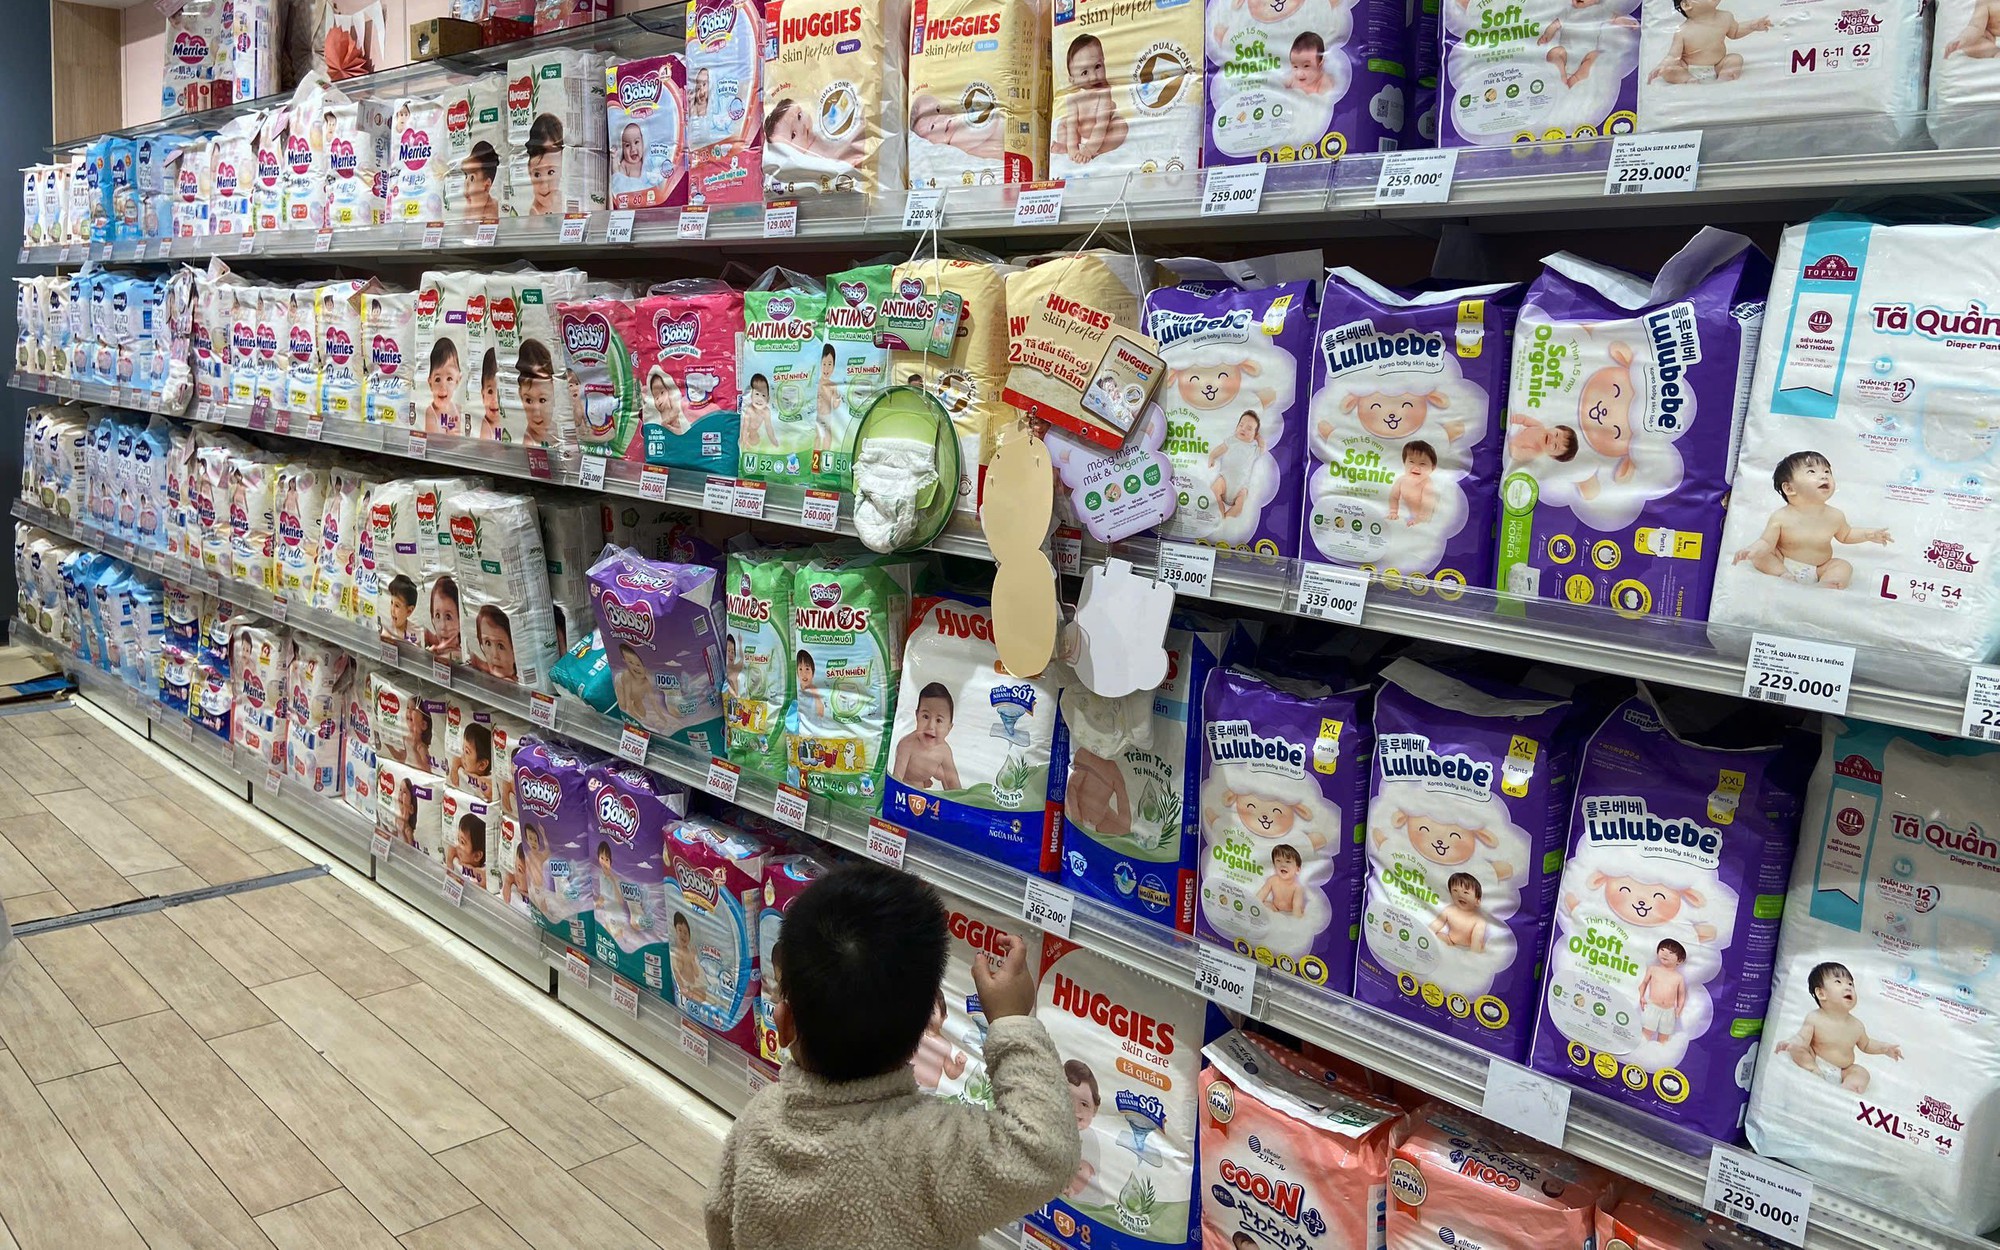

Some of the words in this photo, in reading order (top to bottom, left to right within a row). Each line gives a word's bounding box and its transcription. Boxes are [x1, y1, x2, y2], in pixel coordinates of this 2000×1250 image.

[782, 8, 861, 44] HUGGIES
[927, 13, 1000, 40] HUGGIES
[1080, 12, 1108, 26] skin
[1481, 5, 1522, 30] Soft
[1465, 20, 1540, 49] Organic
[173, 42, 209, 59] Merries
[782, 48, 802, 63] skin
[804, 41, 835, 64] perfect
[1235, 40, 1265, 61] Soft
[1791, 48, 1816, 73] M
[1823, 48, 1844, 58] 6-11
[1852, 44, 1870, 56] 62
[1224, 53, 1281, 78] Organic
[1826, 58, 1839, 68] kg
[330, 151, 357, 170] Merries
[400, 143, 432, 160] Merries
[1387, 172, 1443, 187] 259.000đ
[1619, 165, 1691, 181] 229.000đ
[633, 195, 642, 204] 60
[1210, 188, 1257, 203] 259.000đ
[1018, 202, 1059, 216] 299.000đ
[766, 218, 794, 230] 129.000đ
[1807, 269, 1855, 278] TOPVALU
[769, 303, 792, 314] Bobby
[1046, 294, 1111, 330] HUGGIES
[1466, 303, 1476, 314] L
[1042, 313, 1066, 328] skin
[1066, 319, 1105, 343] perfect
[1872, 307, 1909, 330] Tã
[1915, 303, 2000, 335] Quần
[565, 325, 605, 350] Bobby
[661, 321, 696, 346] Bobby
[1325, 322, 1373, 350] 룰루베베
[1460, 327, 1480, 336] Pants
[1670, 306, 1697, 361] 룰루베베
[289, 339, 313, 353] Merries
[326, 339, 353, 356] Merries
[1025, 339, 1036, 349] Tã
[1038, 341, 1055, 354] đầu
[1057, 348, 1075, 364] tiên
[1076, 361, 1088, 370] có
[1328, 333, 1442, 373] Lulubebe
[372, 349, 401, 364] Merries
[1009, 342, 1022, 363] 2
[1023, 352, 1054, 372] vùng
[1054, 364, 1085, 388] thấm
[1116, 348, 1153, 375] HUGGIES
[1527, 324, 1552, 408] Organic
[1544, 344, 1566, 391] Soft
[1649, 312, 1681, 431] Lulubebe
[1893, 382, 1907, 392] 12
[1168, 422, 1196, 439] Soft
[745, 457, 755, 469] M
[759, 459, 772, 471] 52
[1087, 455, 1115, 472] Mỏng
[1115, 445, 1139, 459] Mềm
[1343, 448, 1381, 468] Soft
[1083, 473, 1103, 486] Mát
[1104, 469, 1112, 477] &
[1113, 451, 1150, 472] Organic
[1330, 460, 1395, 484] Organic
[734, 498, 762, 510] 260.000đ
[804, 509, 835, 521] 260.000đ
[279, 524, 303, 539] Merries
[1507, 520, 1515, 558] KOREA
[1659, 532, 1668, 553] Pants
[1934, 546, 1964, 559] Ngày
[1164, 569, 1206, 583] 339.000đ
[811, 588, 839, 599] Bobby
[1880, 575, 1897, 599] L
[1910, 580, 1935, 592] 9-14
[1941, 586, 1962, 599] 54
[1912, 589, 1926, 602] kg
[1305, 592, 1358, 612] 339.000đ
[243, 684, 266, 702] Merries
[1758, 672, 1841, 697] 229.000đ
[1208, 723, 1249, 739] 룰루베베
[1323, 723, 1338, 734] XL
[1212, 739, 1303, 766] Lulubebe
[1379, 738, 1425, 755] 룰루베베
[1513, 739, 1534, 754] XL
[1124, 748, 1151, 763] Tràm
[1155, 755, 1172, 777] Trà
[1382, 755, 1490, 788] Lulubebe
[1507, 764, 1528, 775] Pants
[1721, 774, 1742, 787] XXL
[1838, 766, 1879, 781] TOPVALU
[521, 777, 560, 805] Bobby
[709, 777, 737, 793] 260.000đ
[807, 775, 828, 790] XXL
[830, 780, 844, 793] 46
[895, 791, 906, 805] M
[911, 799, 921, 810] 76
[1585, 799, 1643, 817] 룰루베베
[600, 797, 634, 832] Bobby
[776, 802, 805, 821] 260.000đ
[1050, 811, 1060, 853] HUGGIES
[1588, 818, 1718, 854] Lulubebe
[1893, 815, 1919, 838] Tã
[1925, 825, 1997, 859] Quần
[868, 839, 903, 859] 385.000đ
[1225, 838, 1252, 859] Soft
[1073, 858, 1084, 871] 68
[1212, 847, 1264, 876] Organic
[1950, 854, 1975, 866] Diaper
[1977, 861, 2000, 873] Pants
[678, 868, 714, 897] Bobby
[1393, 862, 1425, 885] Soft
[1381, 868, 1440, 906] Organic
[1916, 887, 1931, 900] 12
[1182, 878, 1194, 924] HUGGIES
[1029, 902, 1066, 924] 362.200đ
[1586, 927, 1623, 954] Soft
[1569, 936, 1639, 976] Organic
[1200, 971, 1244, 995] 339.000đ
[1052, 973, 1175, 1055] HUGGIES
[1121, 1041, 1144, 1057] skin
[1146, 1051, 1169, 1068] care
[1209, 1096, 1231, 1115] JAPAN
[1855, 1102, 1905, 1139] XXL
[1902, 1122, 1929, 1139] 15-25
[1934, 1135, 1953, 1149] 44
[1909, 1133, 1921, 1145] kg
[1258, 1152, 1286, 1171] エリエール
[1392, 1176, 1422, 1196] JAPAN
[1723, 1188, 1799, 1226] 229.000đ
[1058, 1217, 1071, 1229] 54
[1458, 1239, 1481, 1250] elleair
